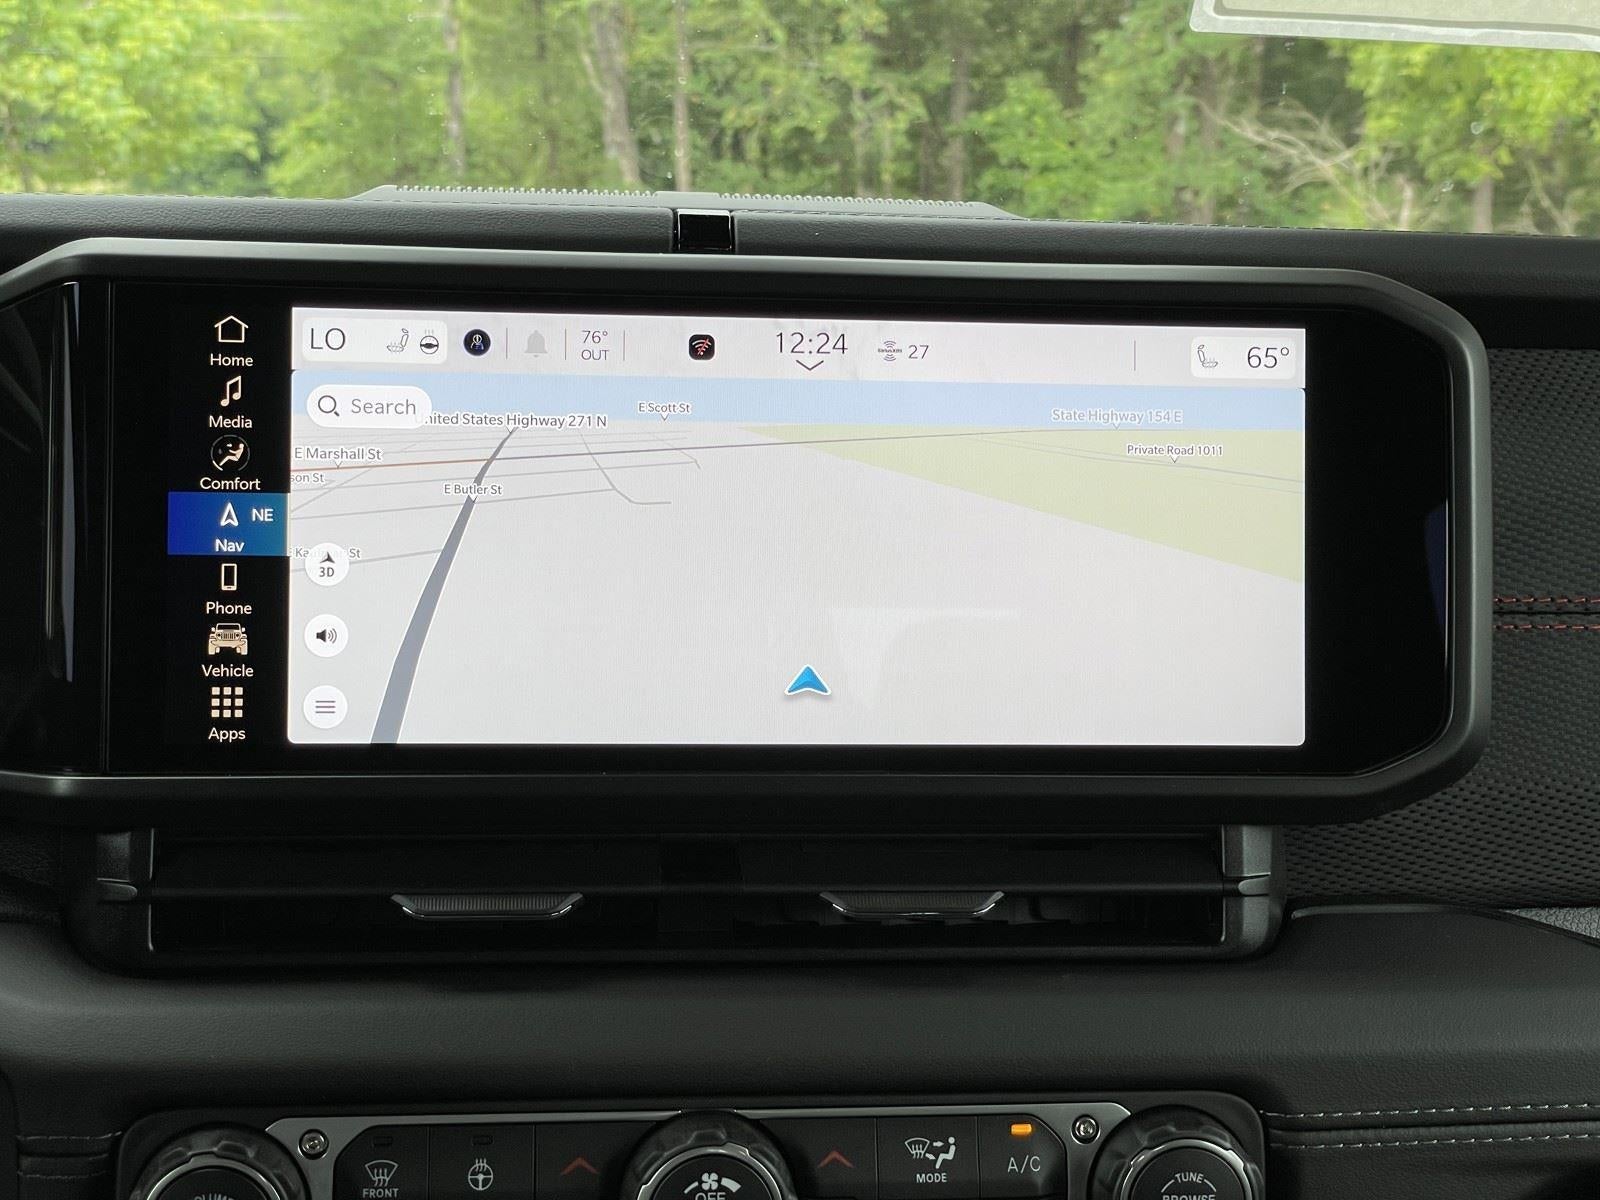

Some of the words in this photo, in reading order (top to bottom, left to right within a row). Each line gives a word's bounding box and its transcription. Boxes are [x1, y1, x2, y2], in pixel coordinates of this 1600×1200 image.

[310, 328, 346, 351] LO
[581, 330, 608, 344] 76°
[776, 332, 848, 355] 12:24
[580, 348, 609, 361] OUT
[908, 344, 929, 359] 27
[1247, 346, 1290, 369] 65°
[209, 353, 254, 367] Home
[350, 397, 417, 416] Search
[638, 402, 645, 413] E
[646, 403, 676, 413] Scott
[679, 403, 691, 413] St
[209, 415, 253, 429] Media
[462, 413, 503, 426] States
[506, 414, 566, 429] Highway
[568, 415, 592, 427] 271
[596, 416, 607, 427] N
[1052, 409, 1085, 421] State
[1088, 409, 1145, 425] Highway
[1148, 411, 1171, 422] 154
[1174, 411, 1183, 422] E
[295, 448, 303, 459] E
[306, 448, 364, 460] Marshall
[368, 449, 382, 460] St
[1127, 444, 1165, 455] Private
[1167, 445, 1194, 455] Road
[1198, 446, 1223, 456] 1011
[199, 477, 261, 491] Comfort
[313, 473, 325, 483] St
[444, 484, 451, 494] E
[454, 484, 489, 494] Butler
[491, 484, 503, 495] St
[252, 509, 273, 522] NE
[215, 539, 244, 553] Nav
[349, 548, 361, 558] St
[319, 566, 335, 577] 3D
[206, 601, 252, 615] Phone
[202, 664, 254, 678] Vehicle
[208, 727, 246, 743] Apps
[1007, 1155, 1041, 1174] A/C
[916, 1173, 948, 1183] MODE
[1175, 1171, 1204, 1184] TUNE
[362, 1188, 399, 1199] FRONT
